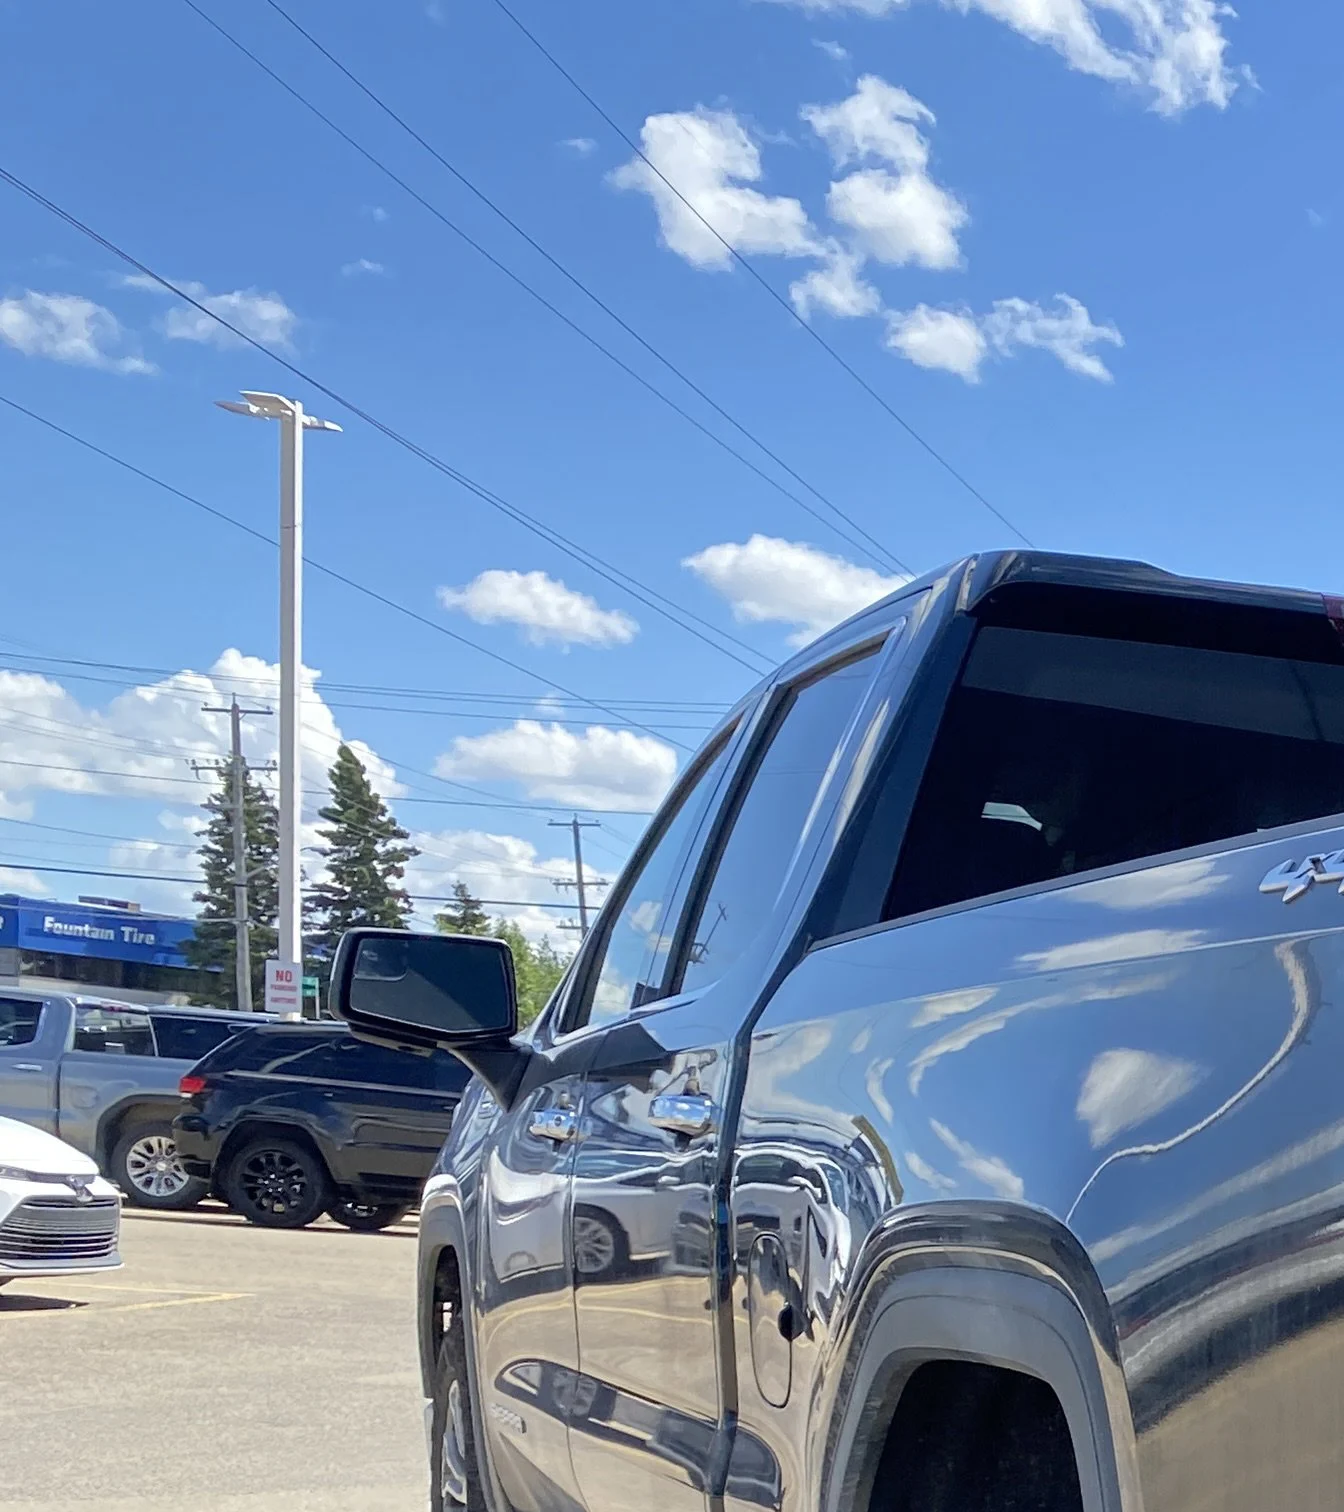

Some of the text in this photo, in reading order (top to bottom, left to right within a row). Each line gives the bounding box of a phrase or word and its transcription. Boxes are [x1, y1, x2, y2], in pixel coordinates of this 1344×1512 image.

[43, 916, 156, 945] Fountain Tire
[275, 969, 293, 983] NO
